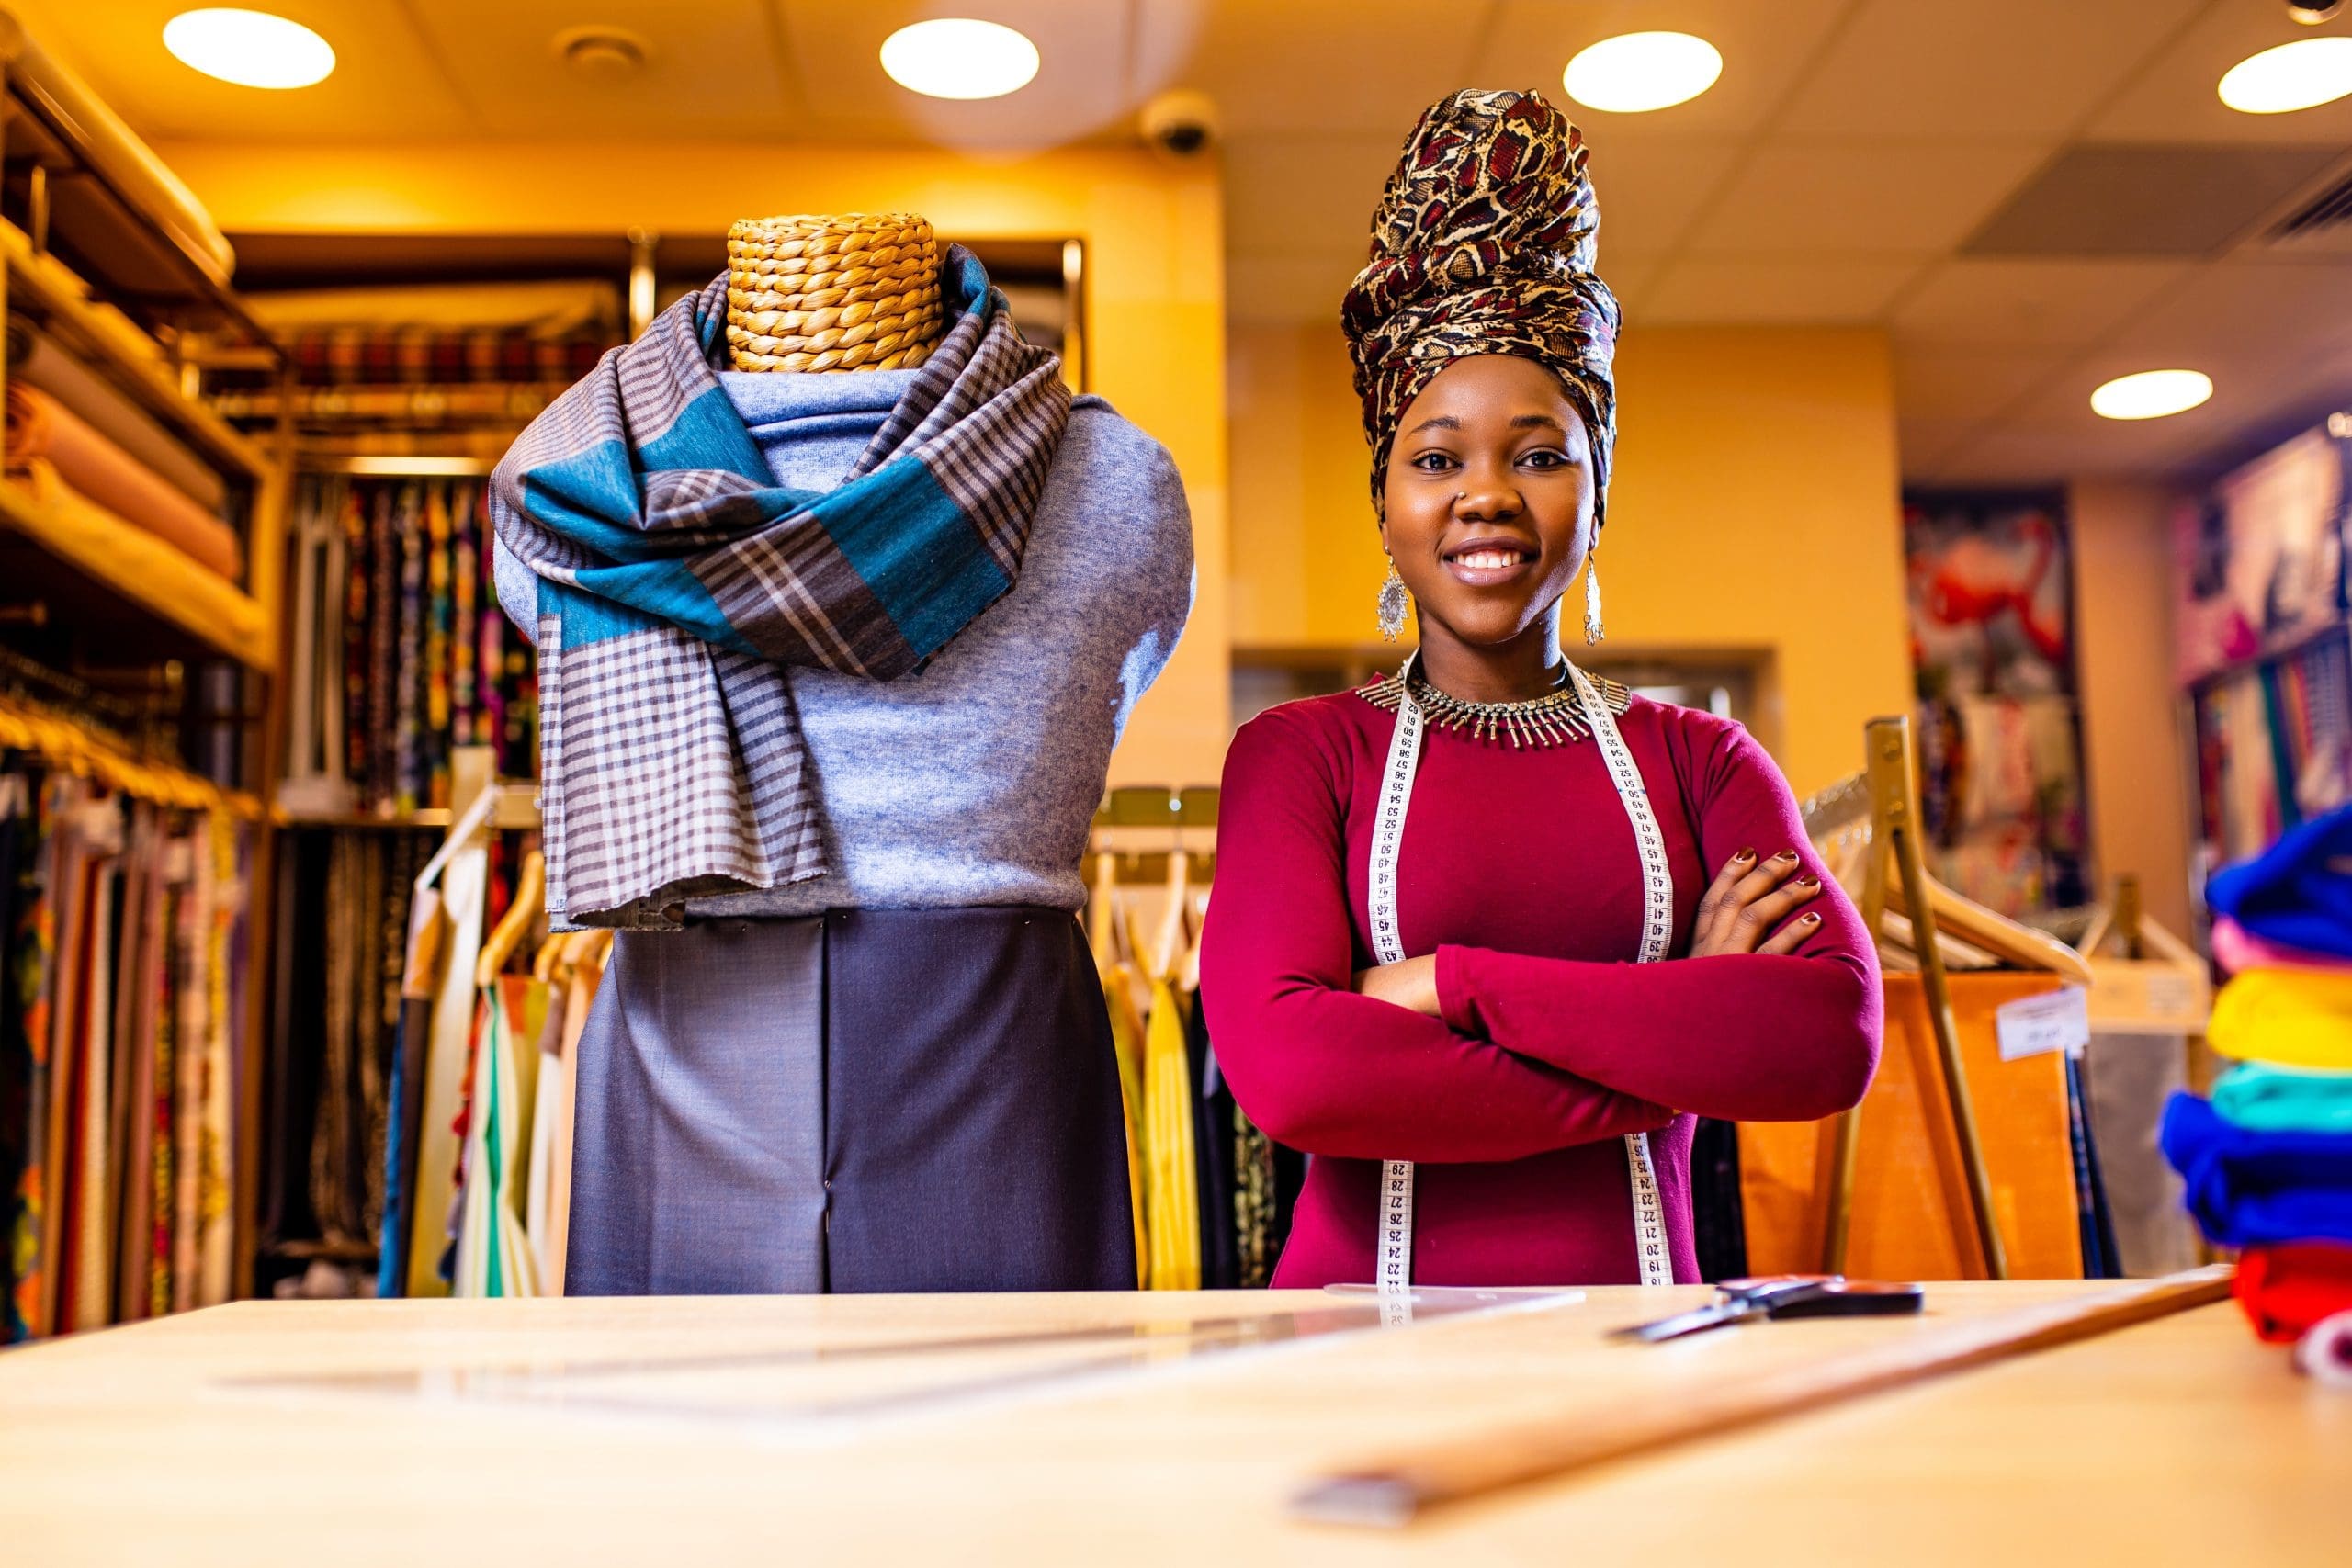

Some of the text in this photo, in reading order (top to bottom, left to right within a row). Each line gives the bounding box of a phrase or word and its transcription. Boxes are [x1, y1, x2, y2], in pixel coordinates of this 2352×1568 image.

[1408, 704, 1418, 714] 62
[1407, 716, 1416, 726] 61
[1599, 719, 1610, 728] 57
[1403, 727, 1414, 737] 60
[1602, 729, 1613, 738] 56
[1401, 739, 1412, 748] 59
[1399, 749, 1410, 759] 58
[1396, 760, 1408, 769] 57
[1395, 772, 1406, 780] 56
[1392, 783, 1404, 792] 55
[1624, 780, 1635, 788] 51
[1390, 794, 1401, 804] 54
[1628, 790, 1640, 799] 50
[1632, 801, 1643, 809] 49
[1387, 807, 1398, 817] 53
[1636, 812, 1647, 820] 48
[1385, 819, 1396, 829] 52
[1642, 824, 1651, 833] 47
[1383, 832, 1393, 841] 51
[1645, 836, 1656, 845] 46
[1381, 845, 1392, 854] 50
[1647, 850, 1658, 859] 45
[1378, 858, 1389, 868] 49
[1650, 863, 1661, 873] 44
[1378, 874, 1389, 884] 48
[1652, 877, 1664, 887] 43
[1653, 893, 1665, 904] 42
[1377, 905, 1389, 915] 46
[1654, 909, 1664, 919] 41
[1378, 920, 1389, 931] 45
[1652, 924, 1664, 935] 40
[1381, 937, 1393, 947] 44
[1649, 942, 1661, 952] 39
[1385, 952, 1396, 962] 43
[1392, 1164, 1405, 1176] 29
[1637, 1162, 1647, 1173] 25
[1391, 1181, 1404, 1192] 28
[1640, 1179, 1650, 1189] 24
[1391, 1198, 1402, 1209] 27
[1642, 1194, 1653, 1205] 23
[1390, 1213, 1402, 1225] 26
[1643, 1212, 1656, 1223] 22
[1389, 1231, 1402, 1242] 25
[1645, 1228, 1657, 1238] 21
[1388, 1247, 1401, 1258] 24
[1646, 1245, 1660, 1256] 20
[1387, 1263, 1400, 1275] 23
[1649, 1261, 1660, 1272] 19
